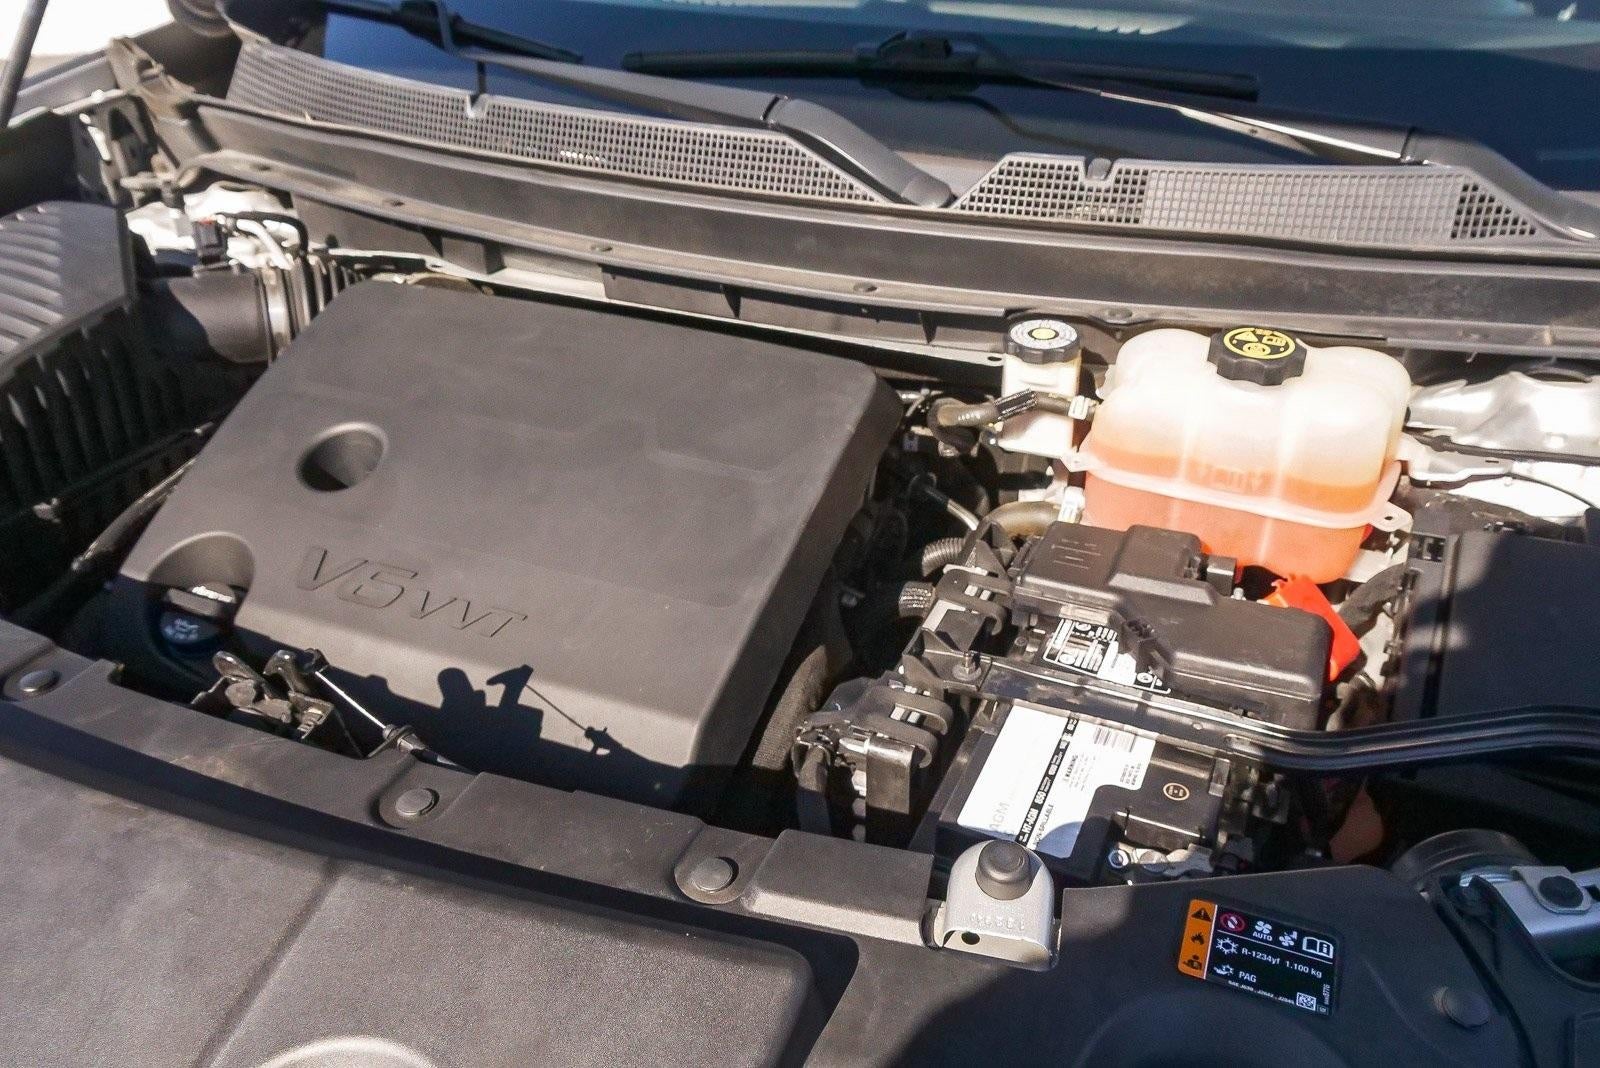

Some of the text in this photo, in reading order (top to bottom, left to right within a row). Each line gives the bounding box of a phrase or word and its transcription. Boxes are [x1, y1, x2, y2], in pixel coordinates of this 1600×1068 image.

[297, 546, 528, 638] V6 VVT
[1252, 931, 1273, 942] AUTO
[1241, 947, 1322, 979] R-1234yf 1.100 kg
[1238, 971, 1257, 983] PAG
